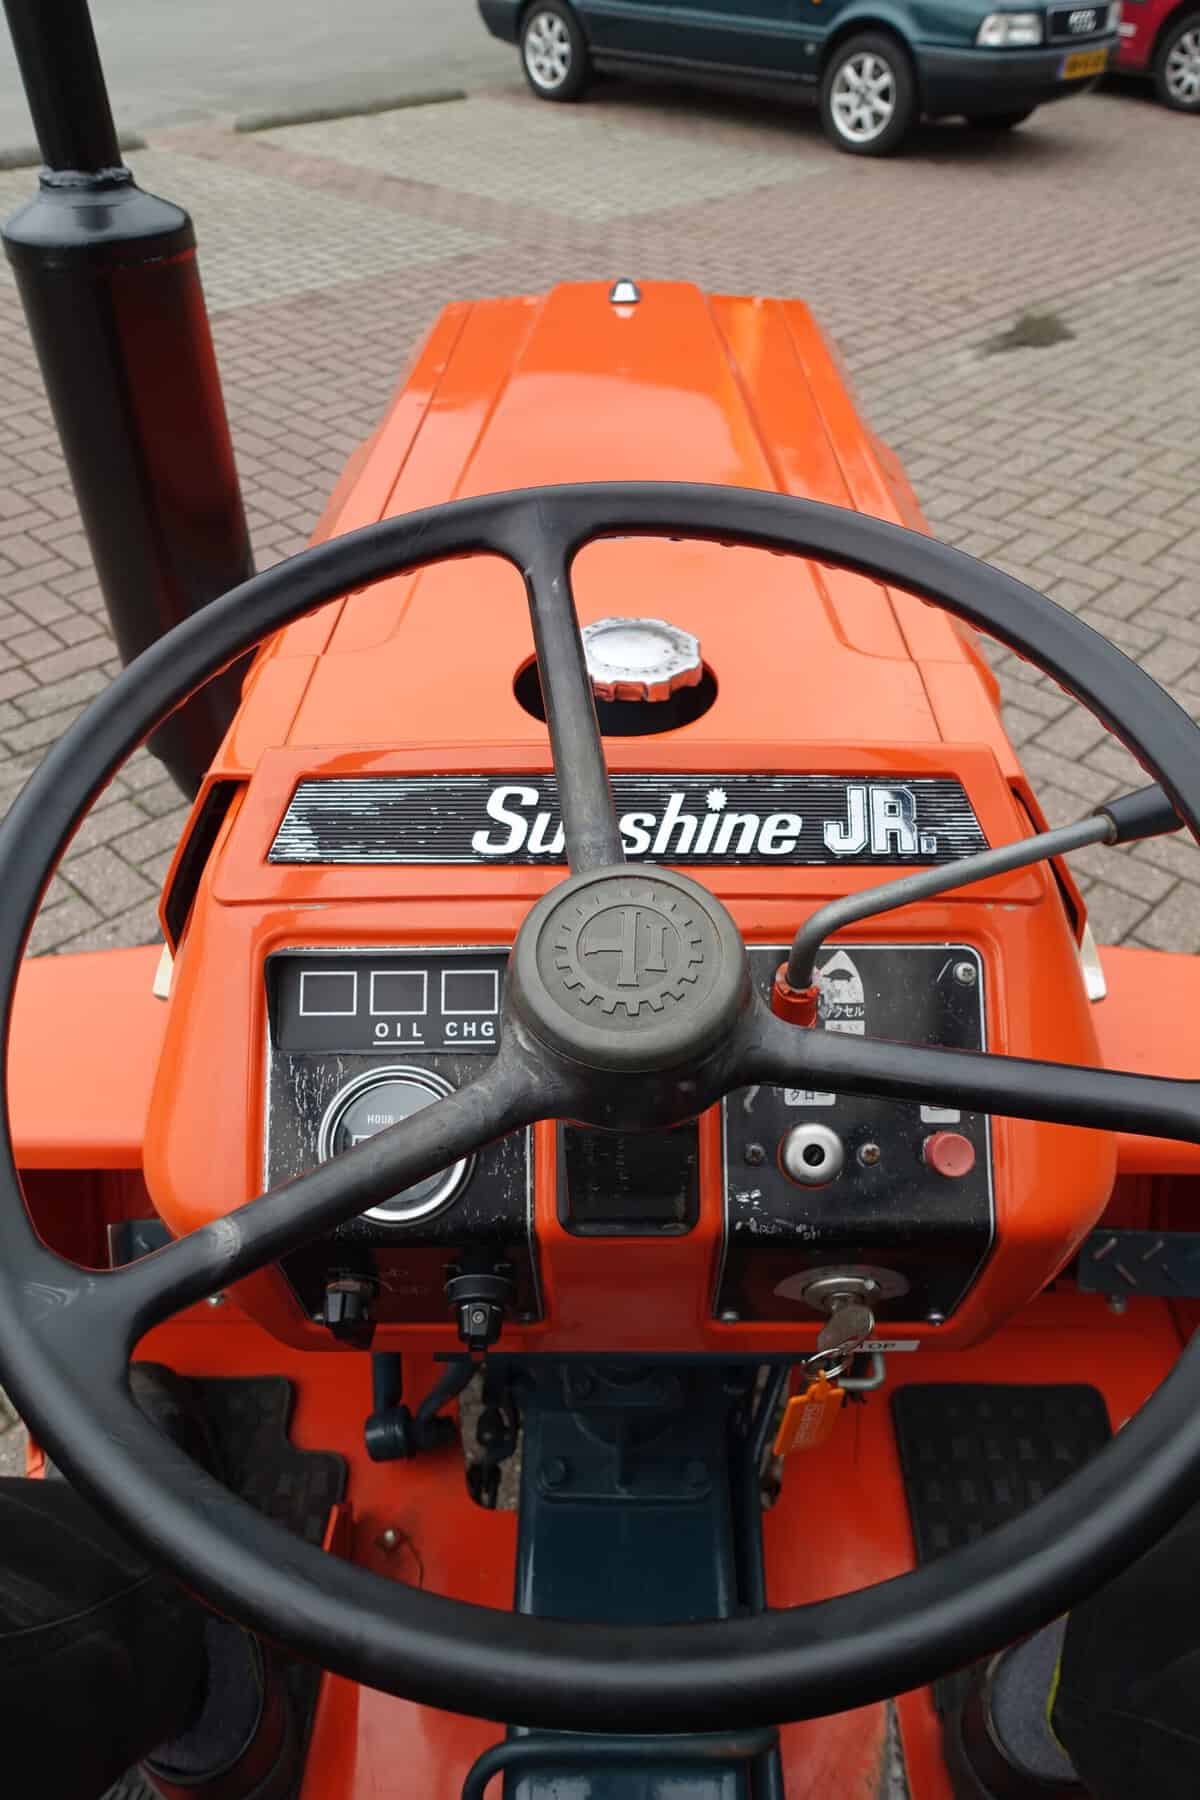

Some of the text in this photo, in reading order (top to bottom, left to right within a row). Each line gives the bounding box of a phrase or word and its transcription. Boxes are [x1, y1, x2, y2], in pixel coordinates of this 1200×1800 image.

[471, 785, 802, 855] Sushine
[375, 1022, 422, 1038] OIL
[446, 1022, 495, 1038] CHG
[853, 1342, 896, 1351] TOP
